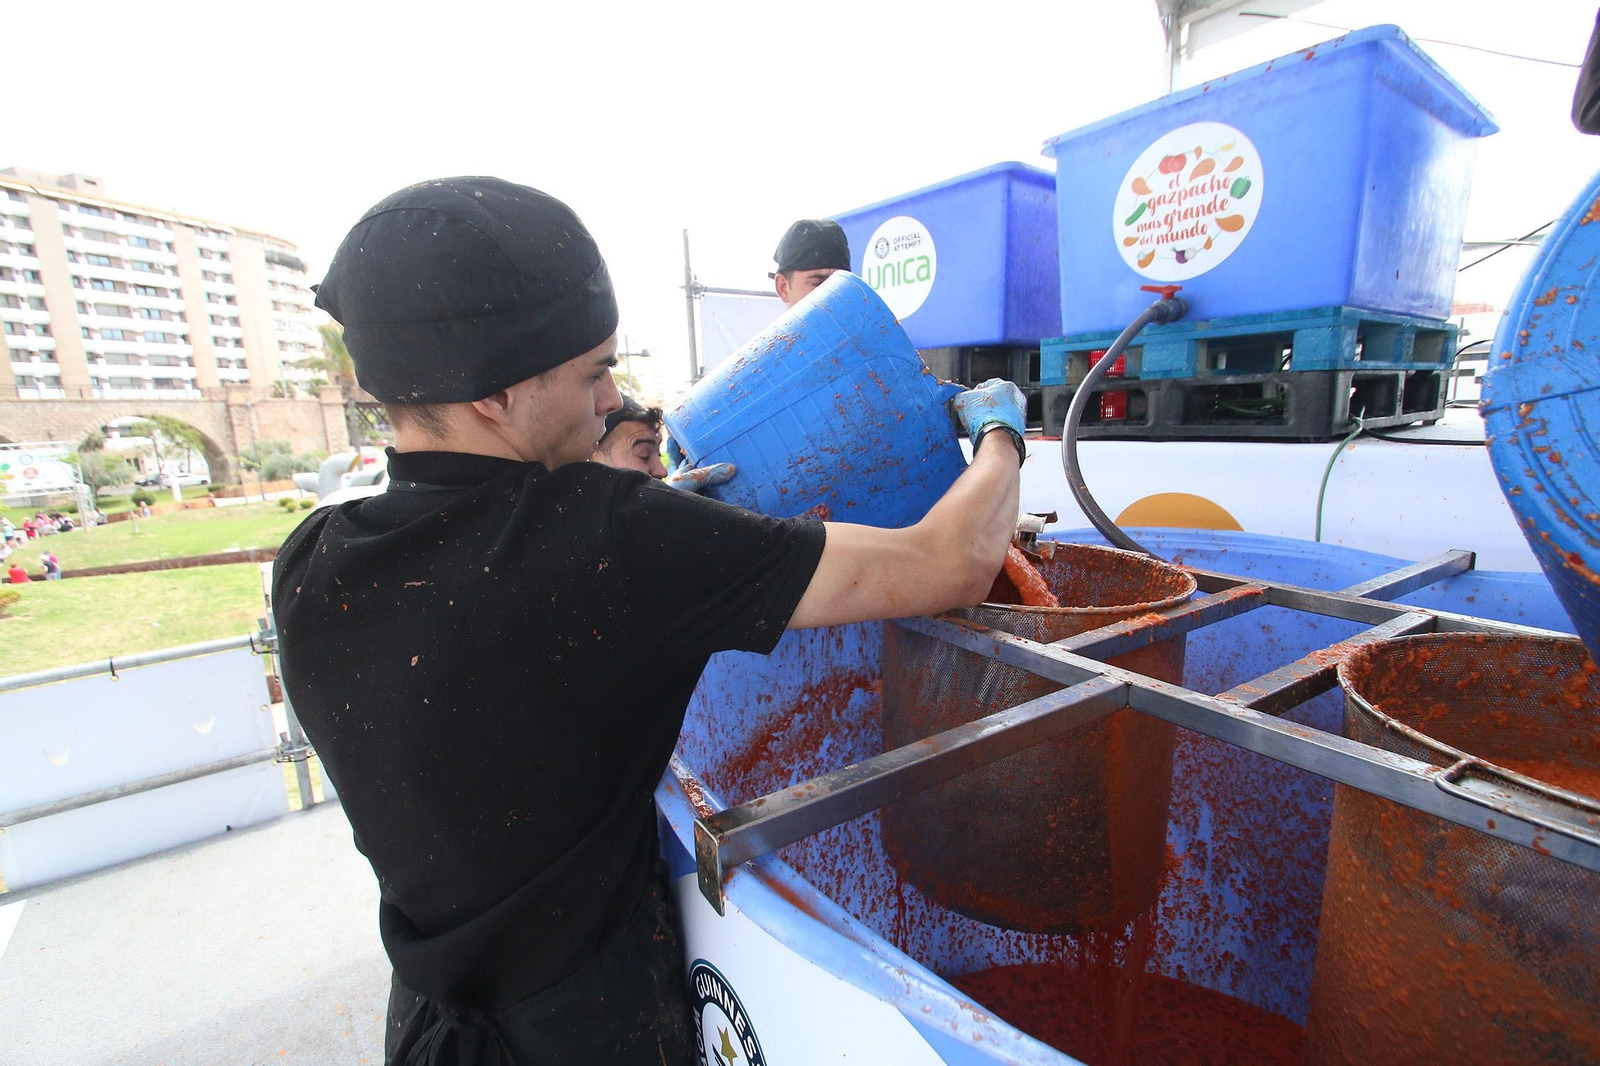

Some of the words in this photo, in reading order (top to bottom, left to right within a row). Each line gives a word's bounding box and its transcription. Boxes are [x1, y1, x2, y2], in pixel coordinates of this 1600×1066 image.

[1168, 173, 1181, 189] el
[1146, 174, 1232, 216] gazpacho
[1163, 196, 1230, 233] grande
[893, 232, 921, 244] OFFICIAL
[893, 240, 921, 251] ATTEMPT
[1139, 234, 1154, 246] del
[1156, 221, 1209, 246] mundo
[696, 973, 762, 1066] GUINNES
